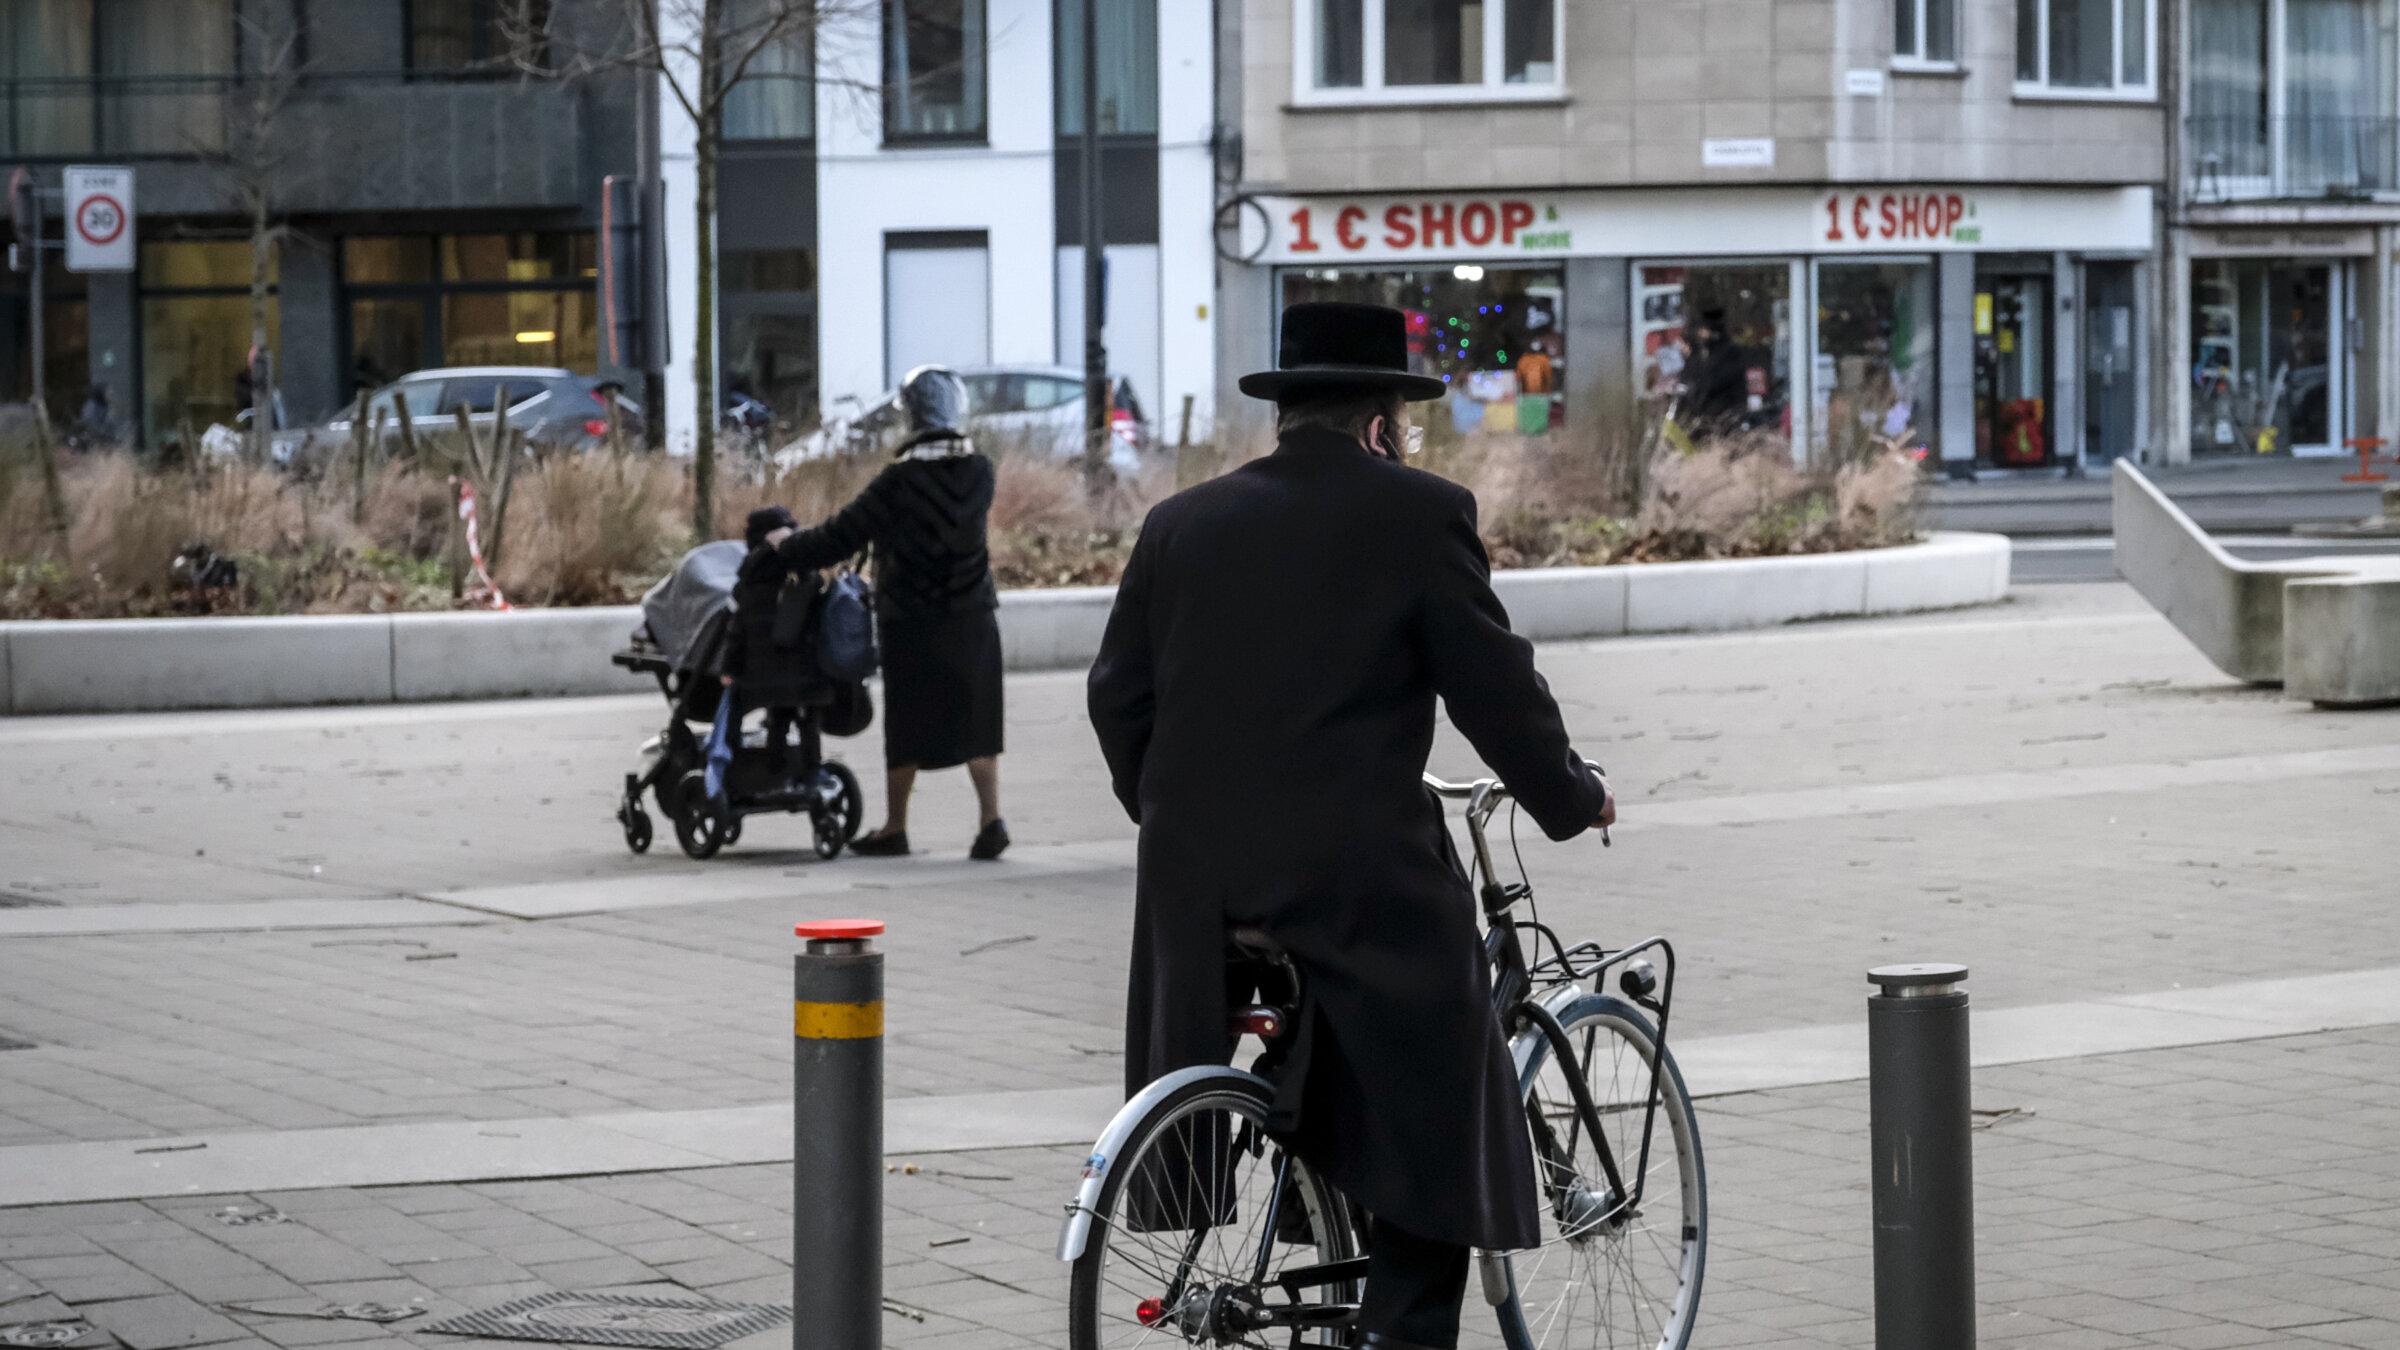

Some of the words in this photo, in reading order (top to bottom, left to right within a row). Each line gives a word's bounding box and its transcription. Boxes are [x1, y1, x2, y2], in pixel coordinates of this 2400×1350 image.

[87, 209, 114, 230] 30
[1289, 207, 1320, 252] 1
[1383, 201, 1535, 250] SHOP
[1825, 197, 1844, 241] 1
[1879, 194, 1964, 239] SHOP
